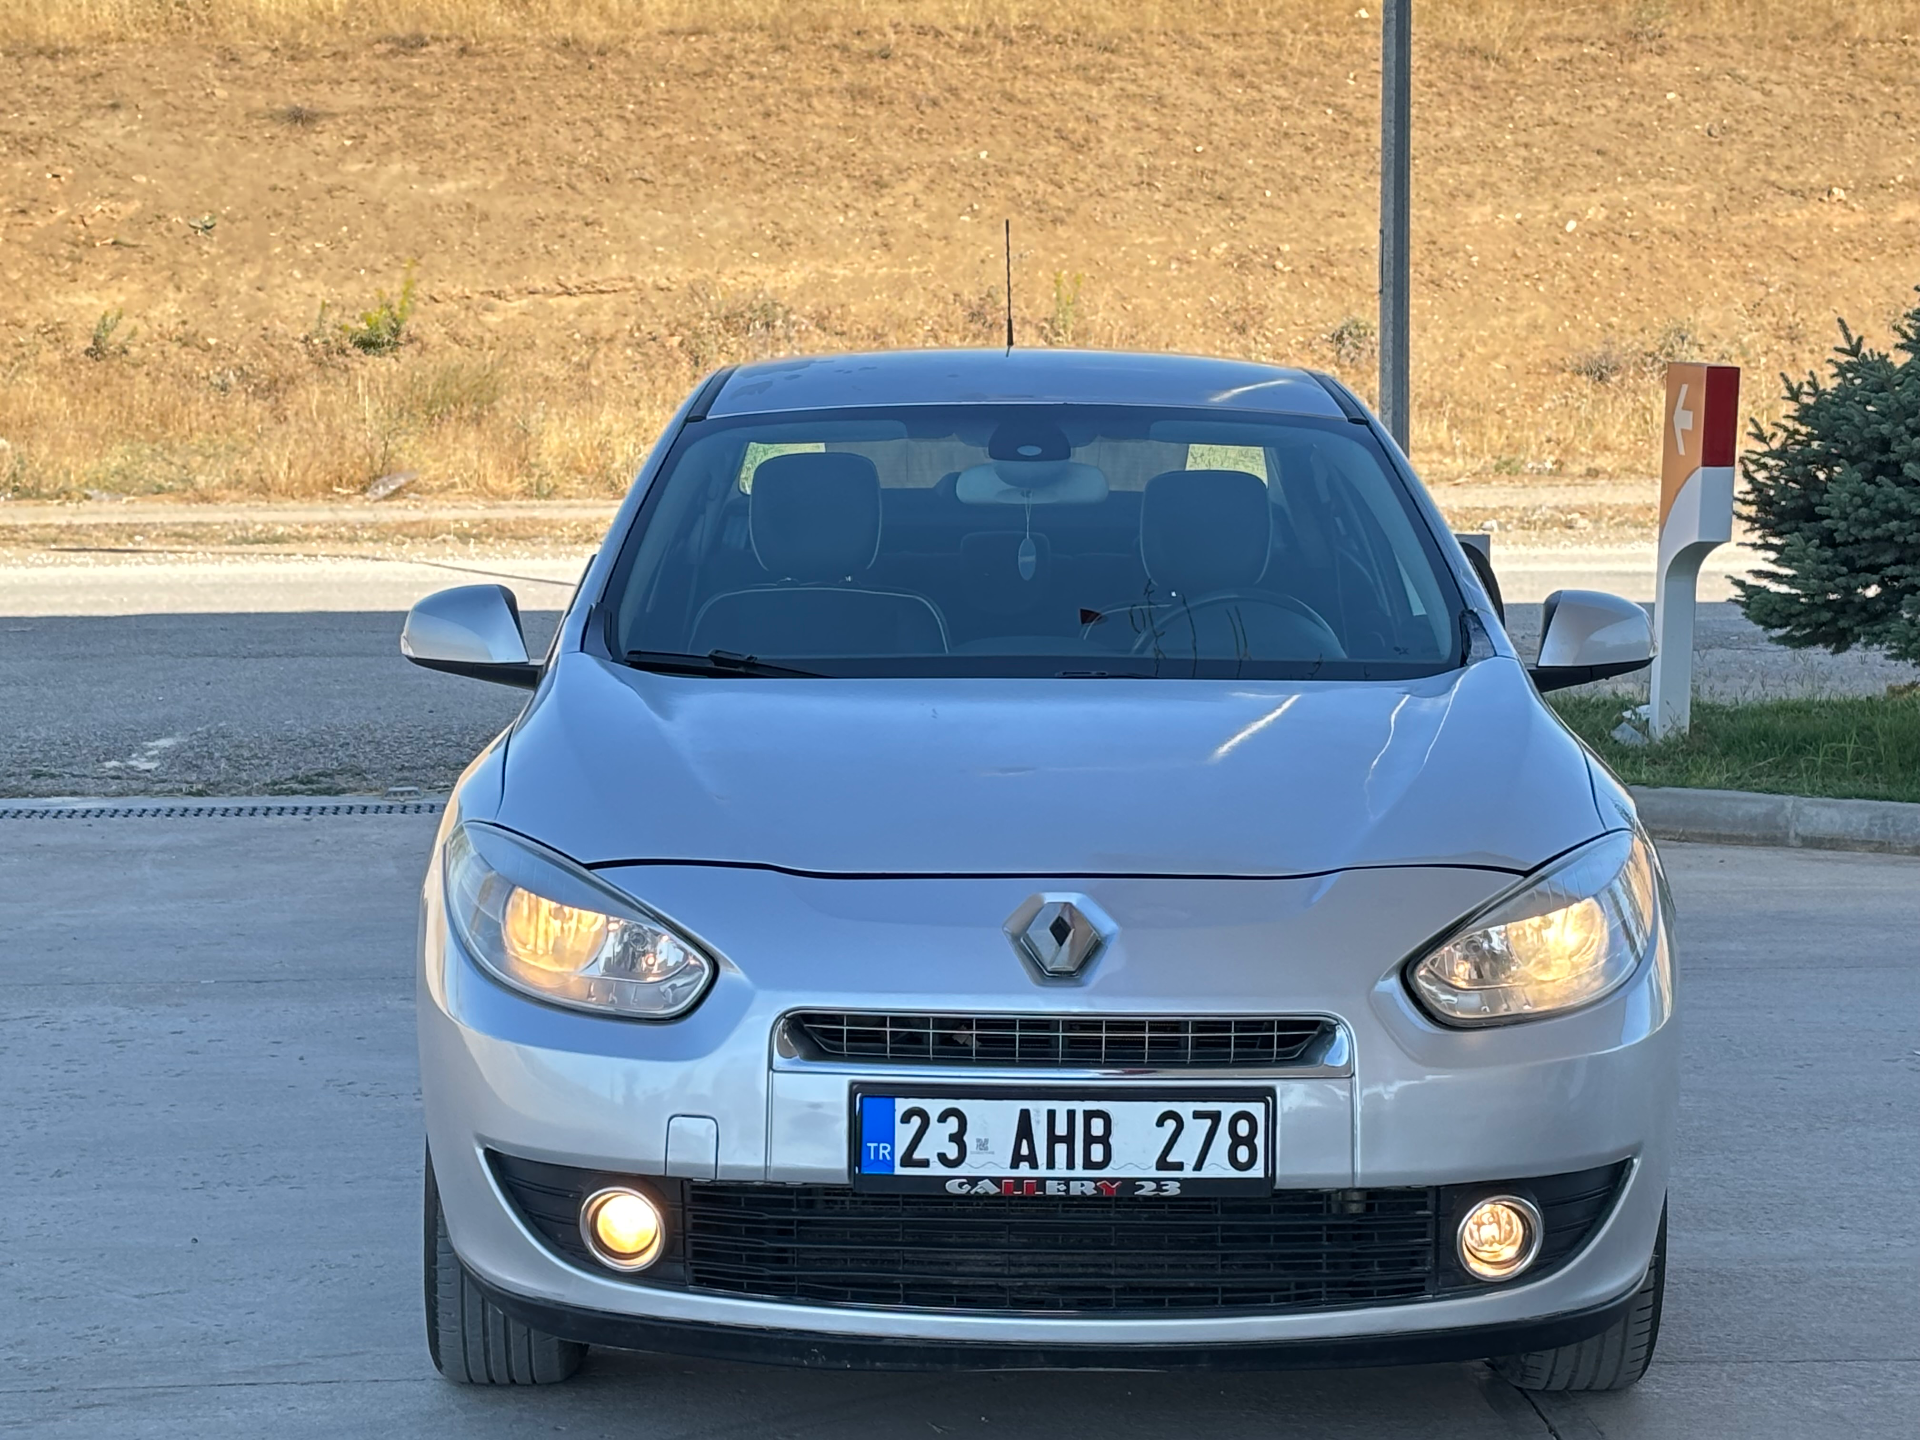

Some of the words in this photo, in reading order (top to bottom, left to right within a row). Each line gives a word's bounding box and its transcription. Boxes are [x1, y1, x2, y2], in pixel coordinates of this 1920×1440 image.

[867, 1143, 891, 1160] TR
[900, 1107, 967, 1168] 23
[1010, 1109, 1112, 1170] AHB
[1155, 1110, 1258, 1171] 278
[945, 1178, 1122, 1196] GALLERY
[1134, 1180, 1181, 1196] 23
